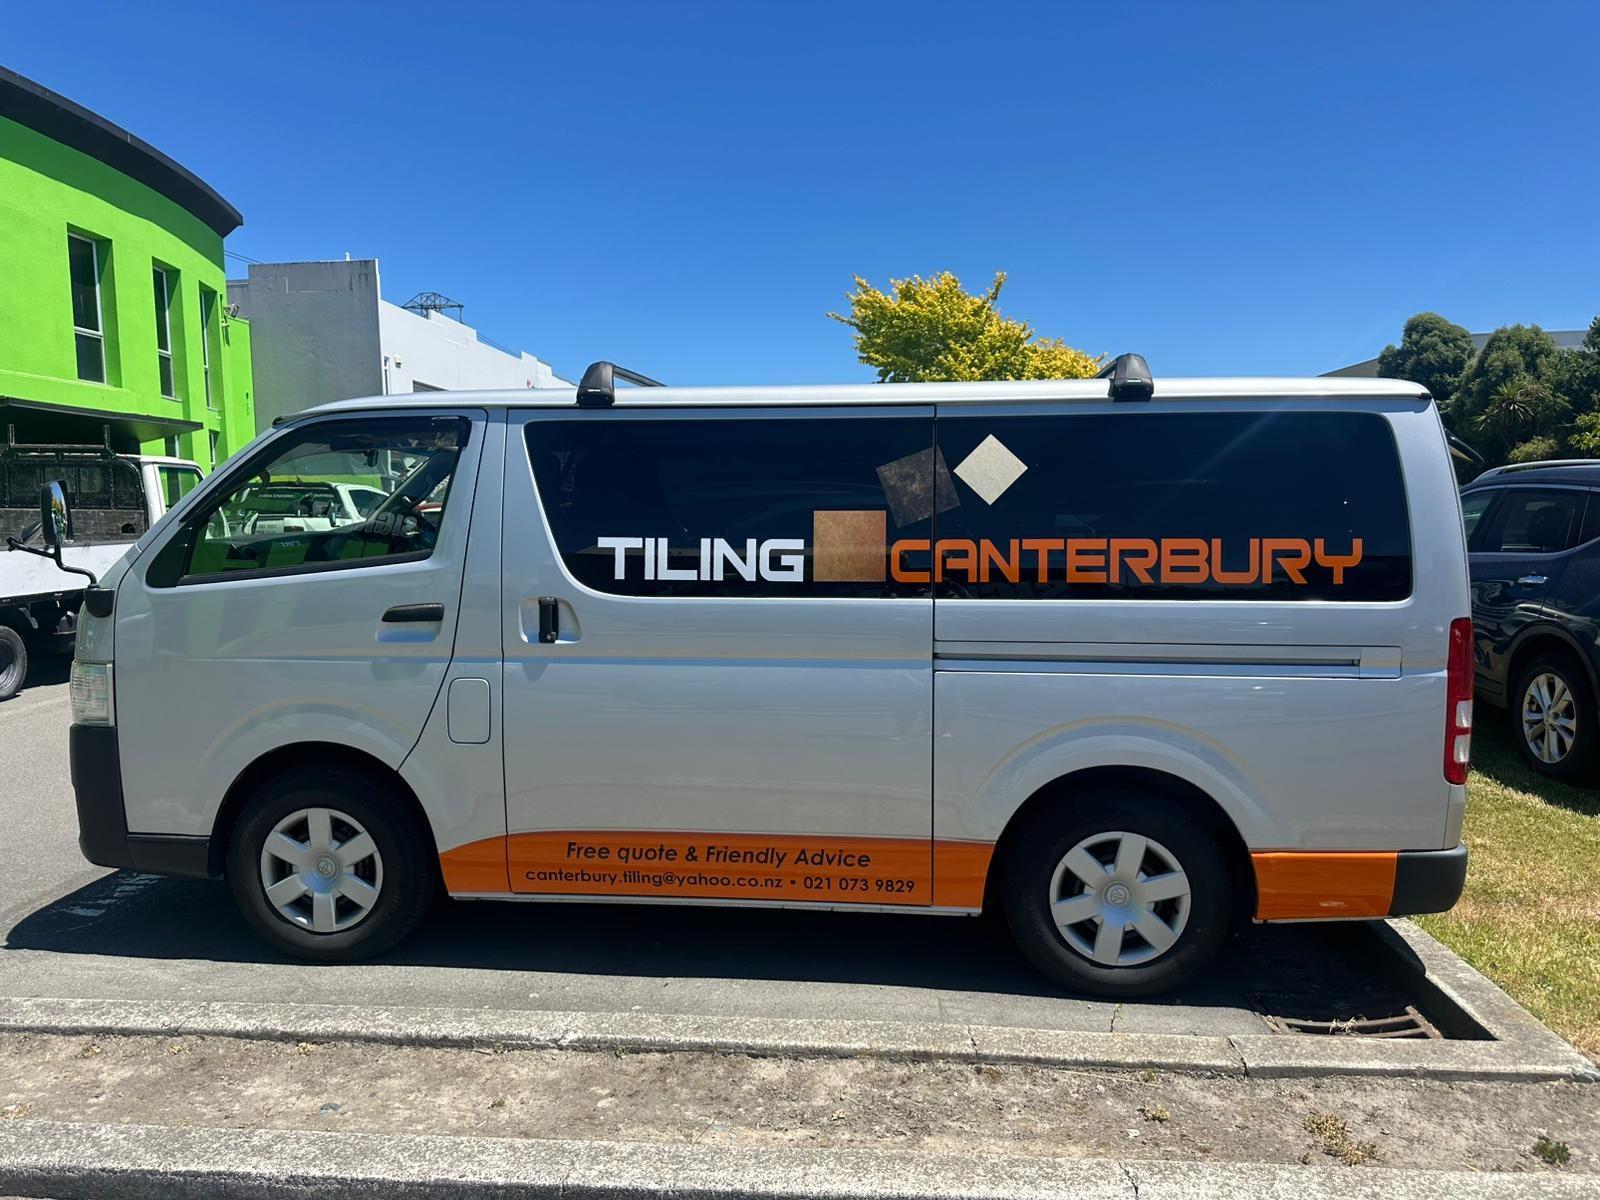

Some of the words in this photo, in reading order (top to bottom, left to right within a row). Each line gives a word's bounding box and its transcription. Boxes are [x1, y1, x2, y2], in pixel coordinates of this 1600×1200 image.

[597, 537, 805, 583] TILING
[890, 538, 1363, 585] CANTERBURY
[566, 842, 611, 860] Free
[617, 844, 678, 864] quote
[684, 845, 699, 863] &
[705, 845, 788, 869] Friendly
[794, 848, 872, 868] Advice
[525, 869, 783, 888] canterbury.tiling@yahoo.co.nz
[803, 876, 832, 890] 021
[838, 877, 870, 892] 073
[875, 879, 916, 893] 9829
